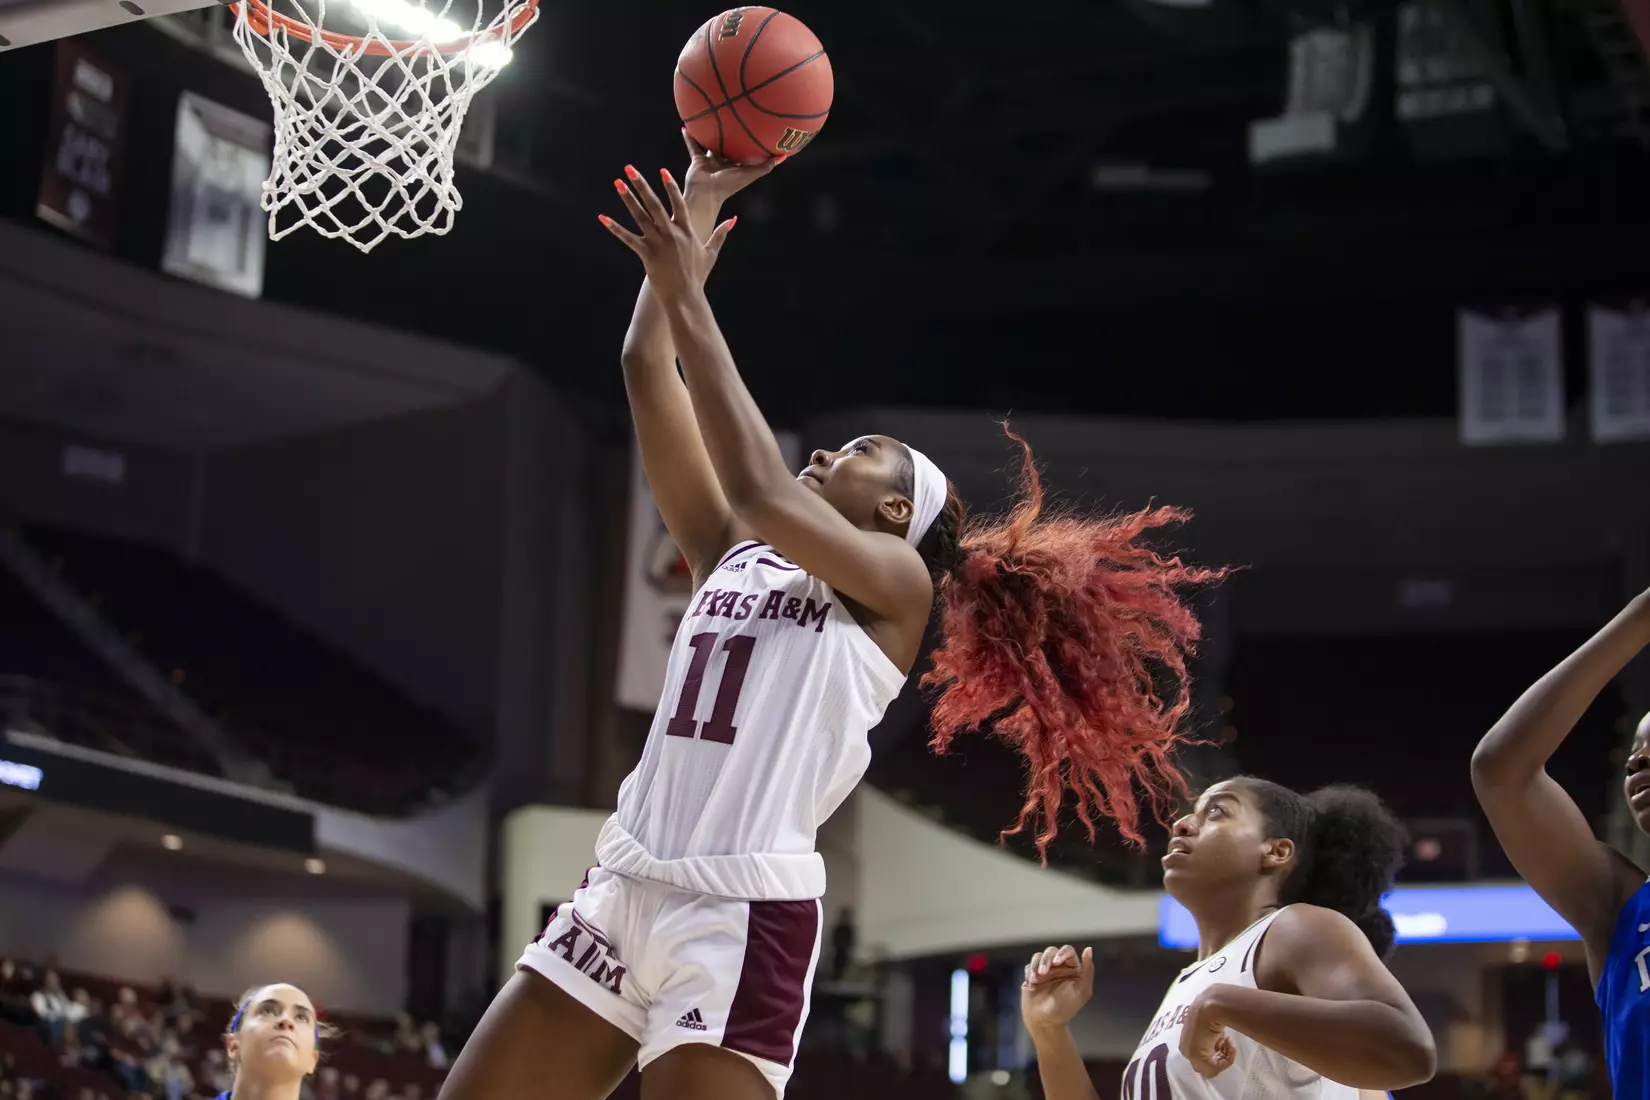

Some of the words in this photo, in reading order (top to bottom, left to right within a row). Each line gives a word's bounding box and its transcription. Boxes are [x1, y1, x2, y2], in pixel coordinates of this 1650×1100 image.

[688, 588, 759, 621] EXAS
[758, 589, 832, 633] A&M
[666, 631, 757, 745] 11
[676, 1019, 707, 1031] adidas
